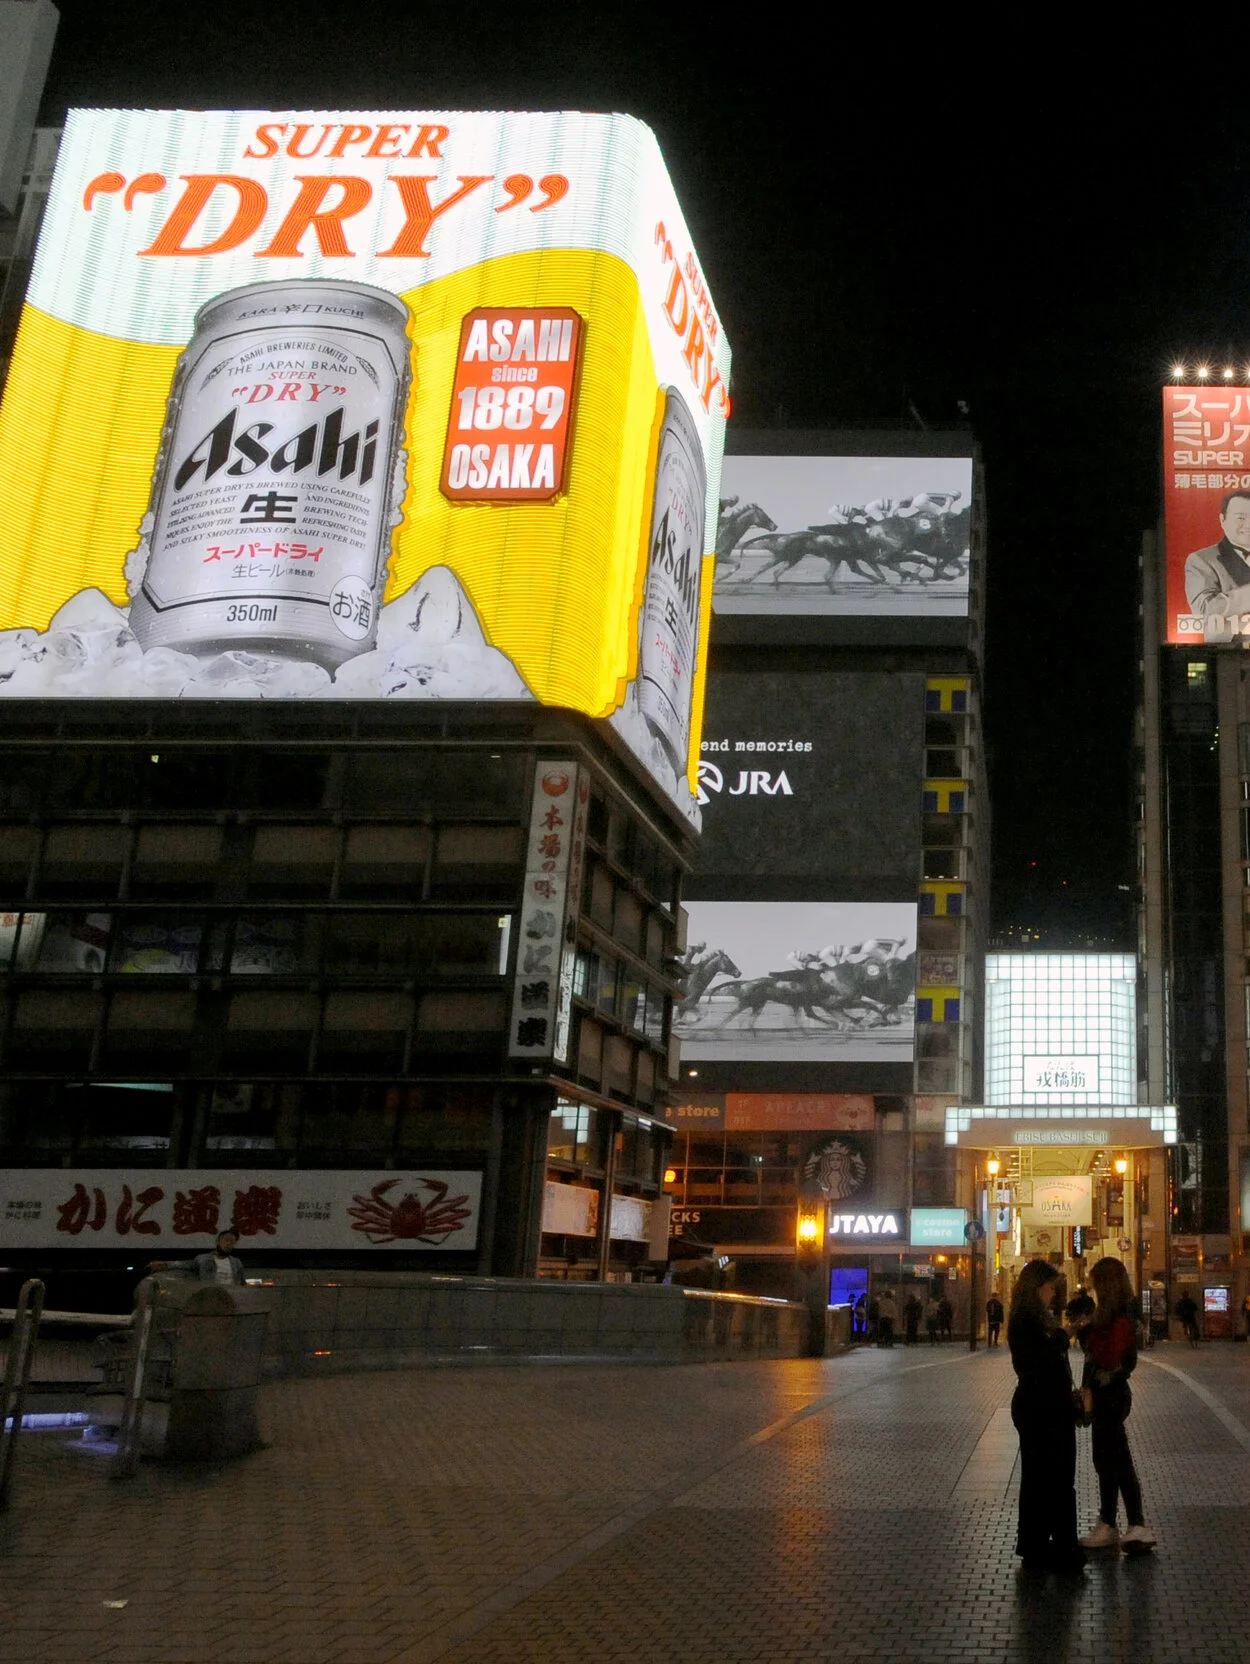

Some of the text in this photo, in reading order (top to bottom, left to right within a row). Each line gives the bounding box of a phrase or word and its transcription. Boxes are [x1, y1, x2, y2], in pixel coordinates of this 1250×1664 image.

[243, 123, 451, 159] SUPER
[324, 306, 364, 317] KUCHI
[462, 317, 573, 362] ASAHI
[240, 342, 349, 364] ASAHI BREWERIES LIMITED
[228, 360, 357, 376] THE JAPAN BRAND
[268, 371, 317, 380] SUPER
[491, 364, 538, 383] since
[457, 386, 566, 432] 1889
[174, 406, 379, 493] Asahi
[1173, 450, 1243, 466] SUPER
[448, 443, 556, 491] OSAKA
[171, 494, 193, 506] ASAHI
[194, 487, 222, 498] SUPER
[224, 483, 243, 492] DRY
[256, 482, 299, 490] BREWED
[301, 483, 328, 492] USING
[330, 487, 370, 504] CAREFULLY
[169, 495, 370, 517] SELECTED YEAST AND INGREDIENTS
[198, 507, 235, 518] ADVANCED
[303, 506, 346, 520] BREWING
[240, 491, 299, 524] 生
[216, 518, 233, 526] THE
[302, 517, 349, 532] REFRESHING
[350, 527, 367, 538] TASTE
[163, 540, 179, 552] AND
[180, 533, 206, 545] SILKY
[206, 526, 272, 539] SMOOTHNESS
[275, 526, 290, 534] OF
[291, 528, 320, 537] ASAHI
[321, 531, 348, 543] SUPER
[203, 542, 324, 563] スーパードライ
[652, 505, 697, 626] Asahi
[226, 604, 278, 622] 350ml
[332, 591, 372, 630] お酒
[735, 740, 813, 752] memories
[729, 770, 794, 795] JRA
[1036, 1071, 1088, 1088] 戎橋筋
[678, 1104, 720, 1117] store
[1016, 1131, 1045, 1142] EBISU
[56, 1183, 282, 1235] かに道楽
